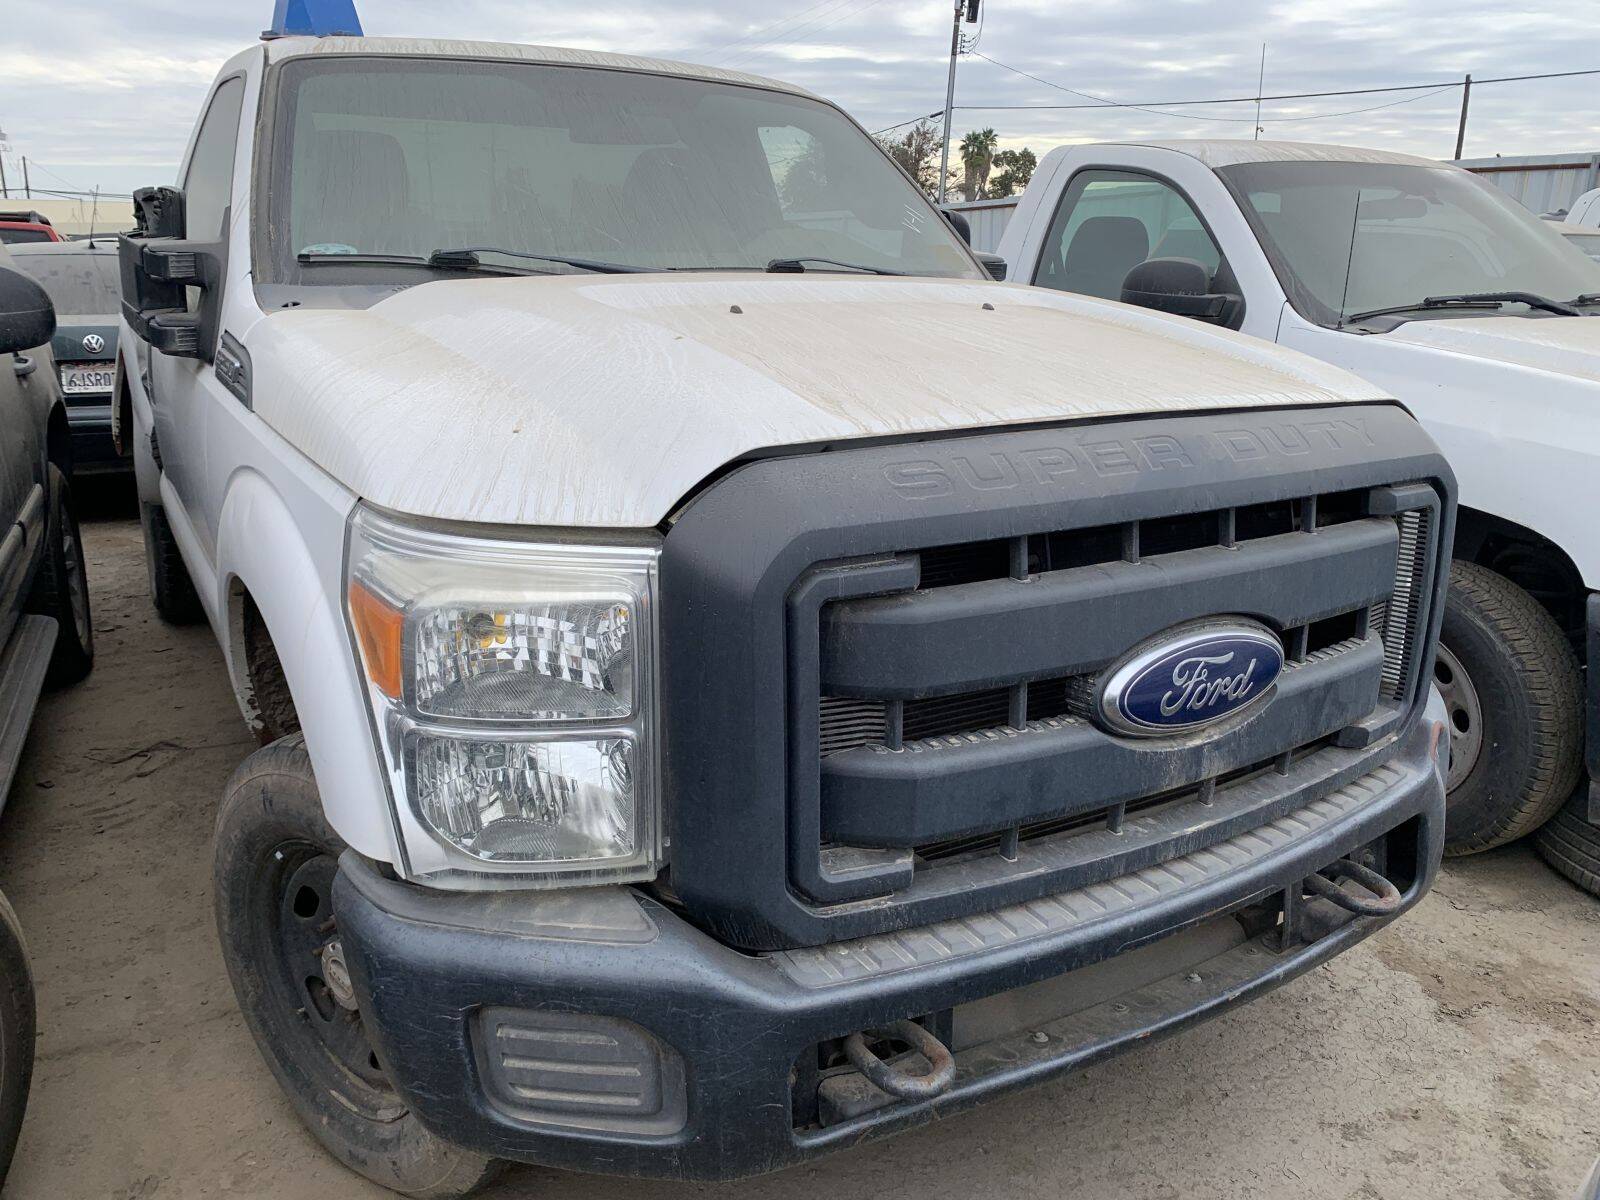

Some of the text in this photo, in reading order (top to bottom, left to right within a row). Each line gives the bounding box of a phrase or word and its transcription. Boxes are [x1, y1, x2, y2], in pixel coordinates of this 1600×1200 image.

[68, 371, 114, 387] 6JSR0
[883, 417, 1376, 501] SUPER DUTY
[1159, 651, 1257, 717] Ford
